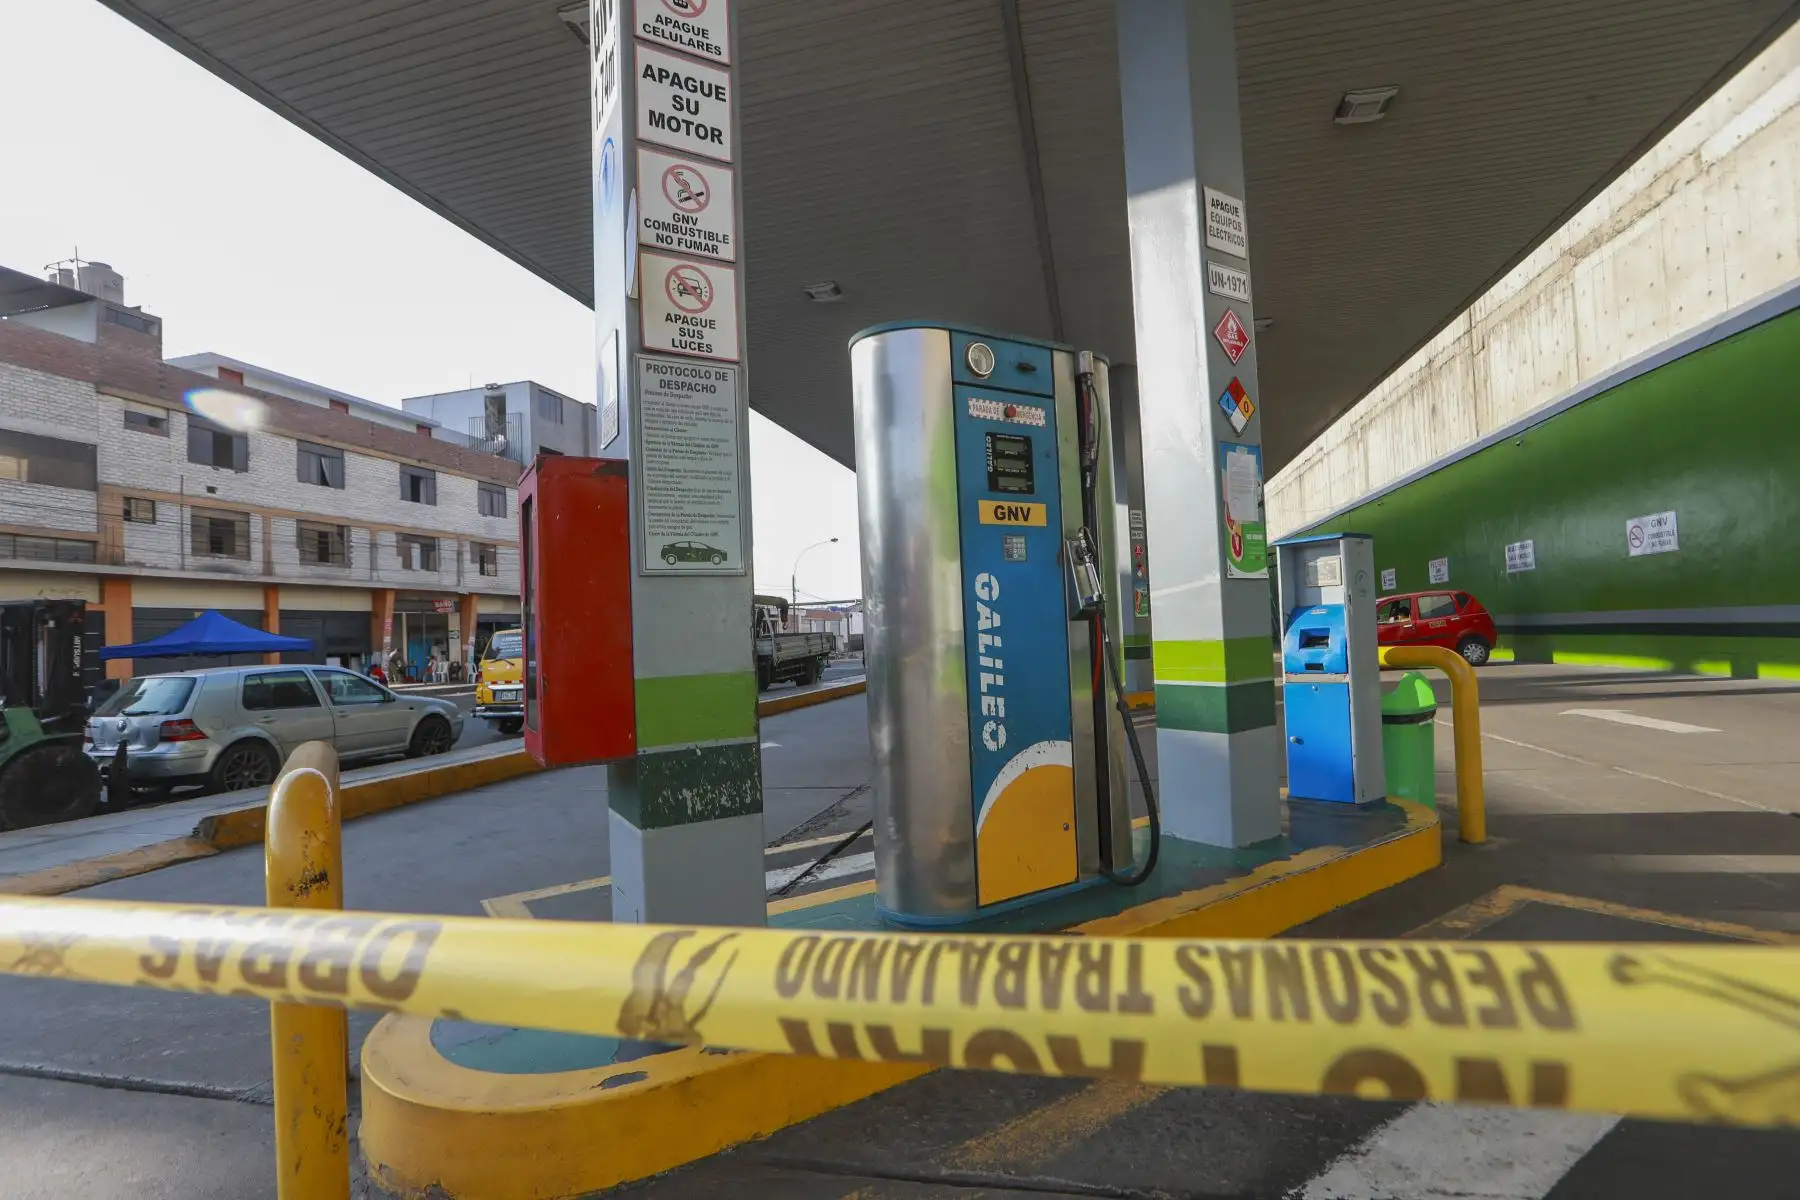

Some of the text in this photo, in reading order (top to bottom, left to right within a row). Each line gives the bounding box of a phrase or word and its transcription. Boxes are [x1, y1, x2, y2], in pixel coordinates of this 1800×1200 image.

[655, 14, 709, 40] APAGUE
[642, 23, 722, 56] CELULARES
[642, 63, 727, 103] APAGUE
[672, 94, 699, 116] SU
[648, 109, 723, 145] MOTOR
[1211, 198, 1240, 218] APAGUE
[672, 212, 699, 226] GNV
[1210, 212, 1242, 232] EQUIPOS
[644, 218, 730, 245] COMBUSTIBLE
[1209, 225, 1245, 247] ELECTRICOS
[655, 232, 719, 255] NO FUMAR
[1211, 269, 1247, 294] UN-1971
[665, 312, 717, 330] APAGUE
[679, 327, 704, 340] SUS
[671, 338, 713, 354] LUCES
[1231, 349, 1236, 357] 2
[645, 363, 729, 382] PROTOCOLO DE
[659, 379, 717, 394] DESPACHO
[1225, 398, 1230, 409] 1
[1243, 401, 1250, 413] 0
[993, 505, 1031, 521] GNV
[1650, 516, 1668, 528] GNV
[975, 572, 1007, 752] GALILEO
[138, 909, 443, 1001] OBRAS
[774, 935, 1578, 1030] PERSONAS TRABAJANDO
